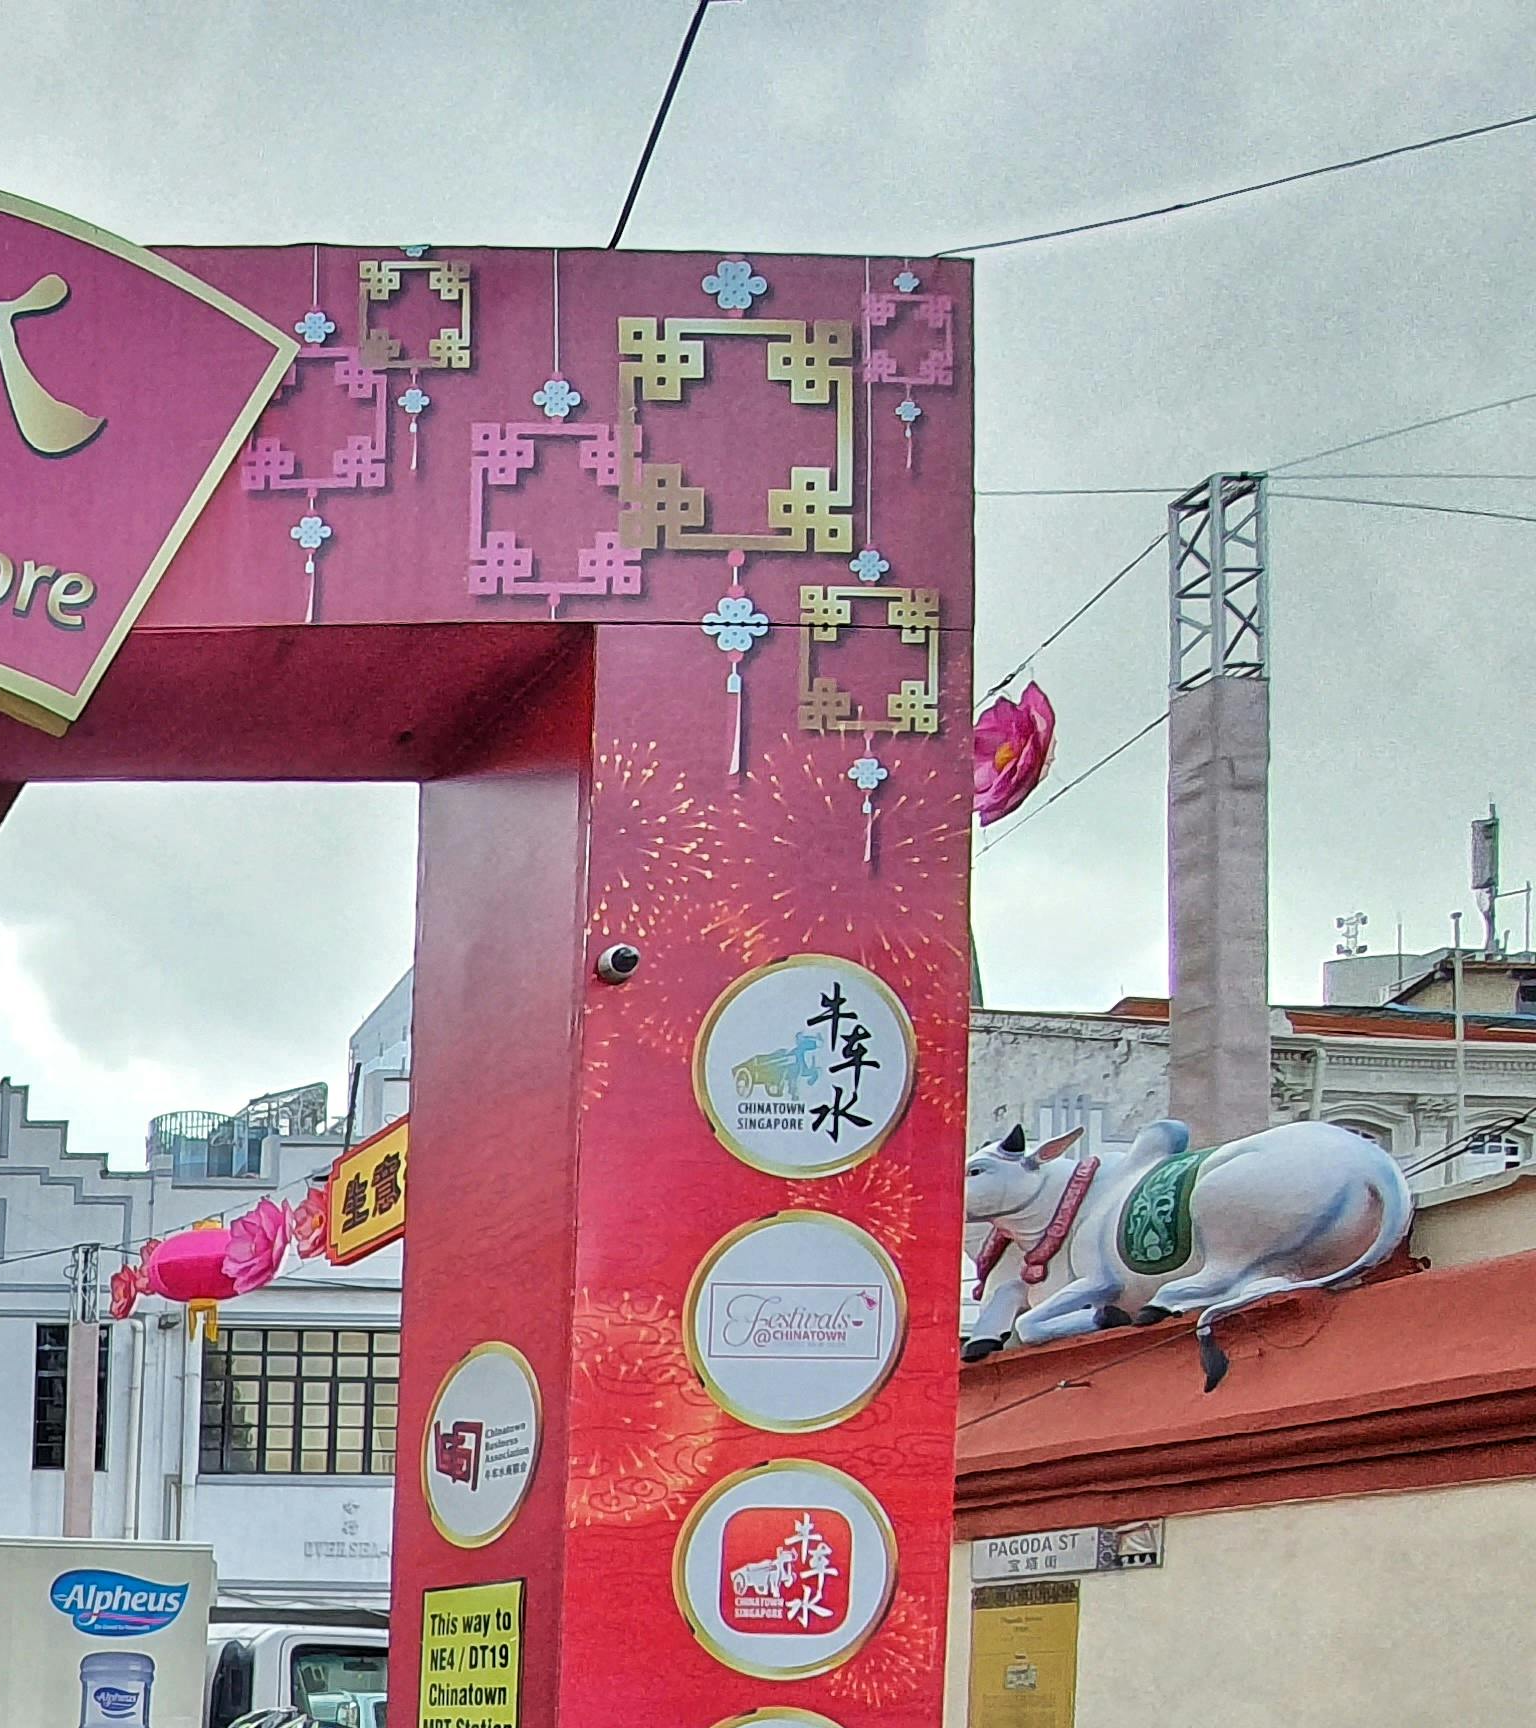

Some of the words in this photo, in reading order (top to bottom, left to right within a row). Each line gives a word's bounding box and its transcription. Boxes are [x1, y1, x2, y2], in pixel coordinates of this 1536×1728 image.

[807, 981, 881, 1143] 牛车水
[737, 1103, 805, 1115] CHINATOWN
[737, 1117, 804, 1130] SINGAPORE
[723, 1293, 851, 1346] Festivals
[752, 1328, 847, 1347] @CHINATOWN
[988, 1536, 1053, 1558] PAGODA
[1058, 1533, 1080, 1550] ST
[784, 1512, 839, 1629] 牛车水
[1008, 1554, 1057, 1573] 宝塔街
[54, 1584, 182, 1626] Alpheus
[430, 1612, 458, 1637] This
[462, 1614, 491, 1638] way
[495, 1608, 512, 1632] to
[430, 1647, 455, 1672] NE4
[469, 1644, 509, 1670] DT19
[429, 1683, 507, 1707] Chinatown
